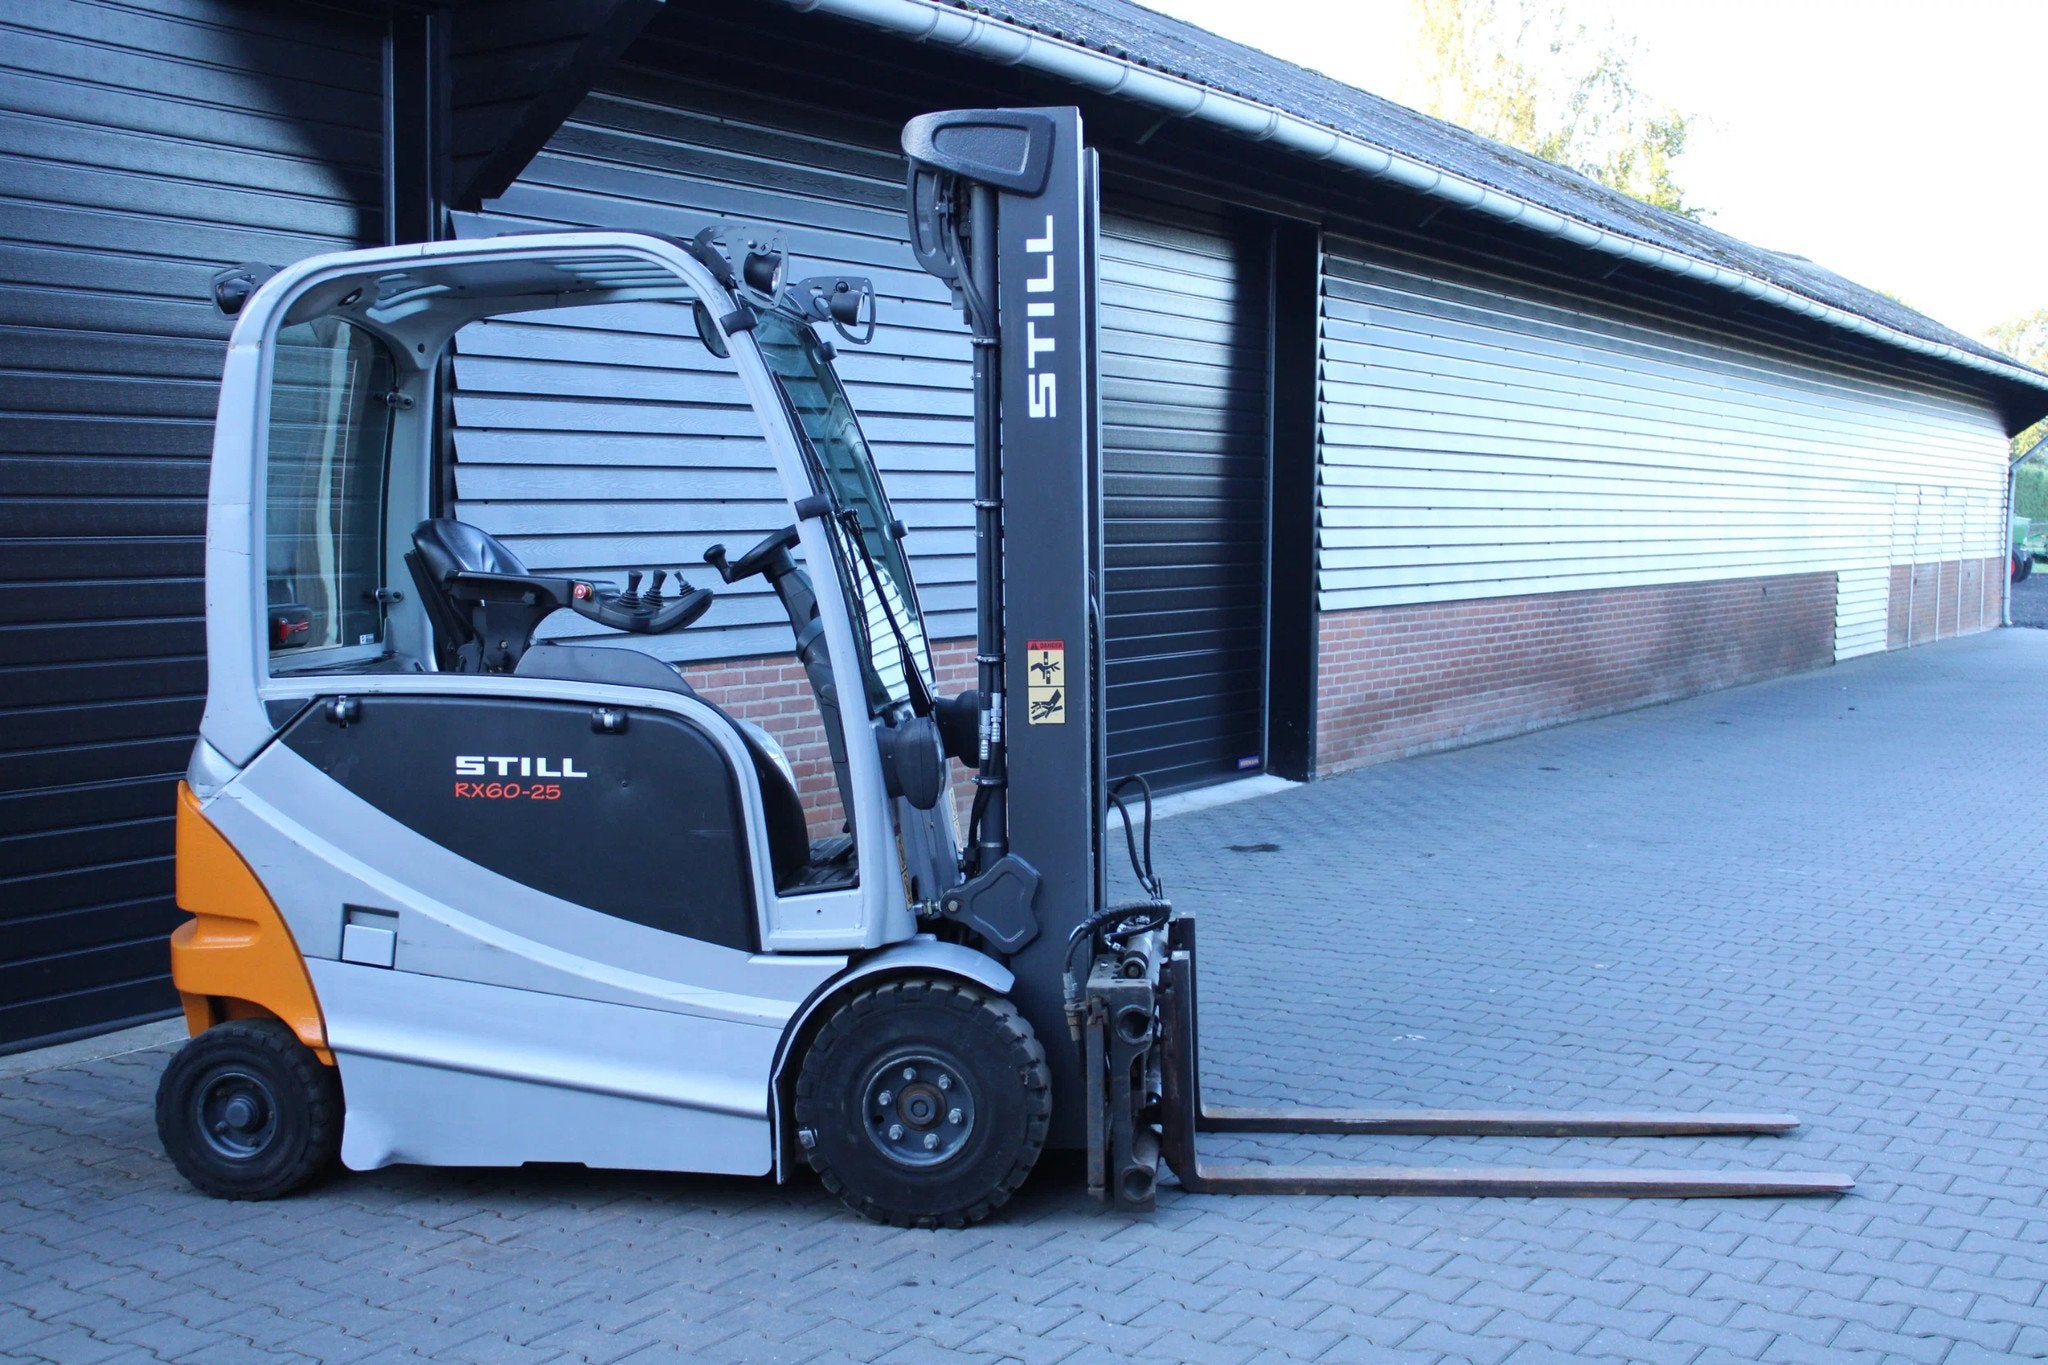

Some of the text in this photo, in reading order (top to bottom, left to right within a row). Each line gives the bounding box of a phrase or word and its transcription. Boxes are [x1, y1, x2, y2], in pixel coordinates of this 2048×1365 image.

[1026, 215, 1057, 418] STILL
[455, 756, 588, 778] STILL
[454, 782, 562, 800] RX60-25
